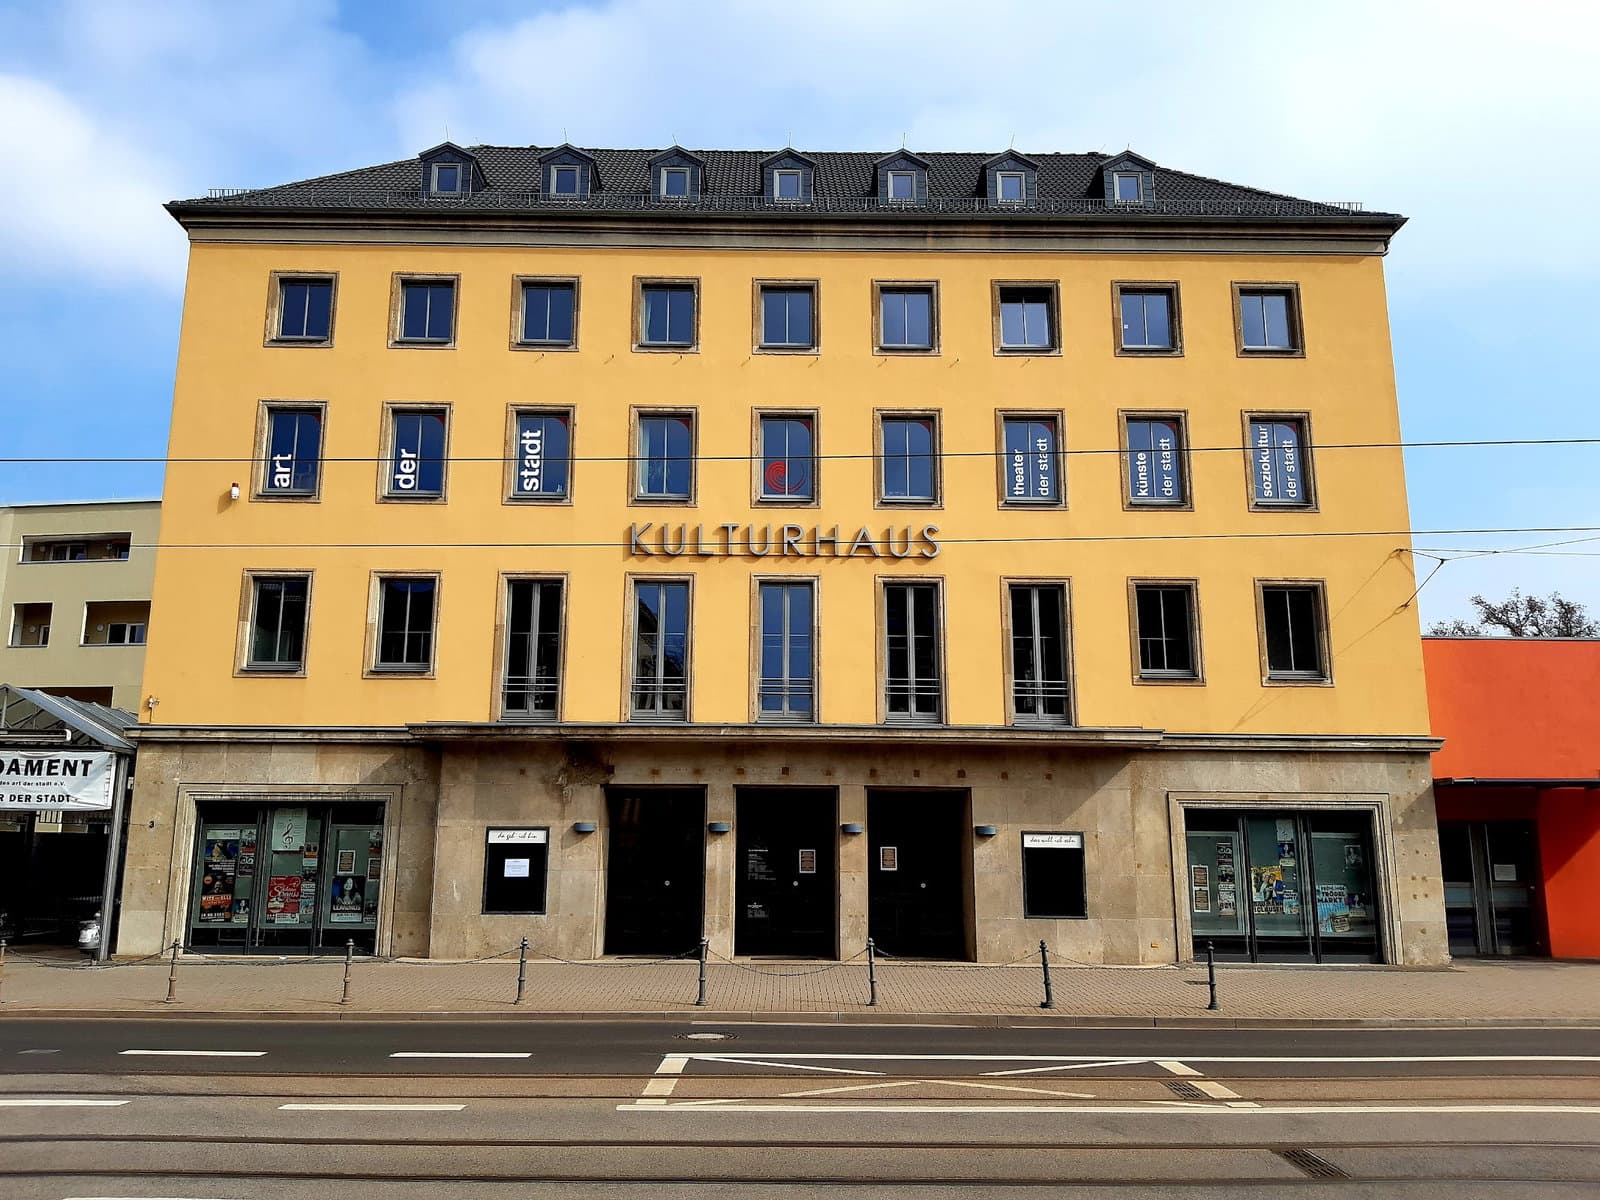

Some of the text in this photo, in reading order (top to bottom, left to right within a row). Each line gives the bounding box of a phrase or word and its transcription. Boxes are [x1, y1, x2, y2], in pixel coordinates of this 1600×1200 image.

[272, 454, 292, 487] art
[394, 448, 417, 489] der
[520, 430, 541, 491] stadt
[1013, 449, 1024, 495] theater
[1036, 438, 1049, 496] der stadt
[1136, 452, 1148, 496] künste
[1159, 438, 1173, 496] der stadt
[1257, 426, 1272, 497] soziokultur
[1282, 440, 1297, 497] der stadt
[631, 522, 942, 559] KULTURHAUS
[9, 794, 32, 803] DER
[36, 794, 70, 803] STADT
